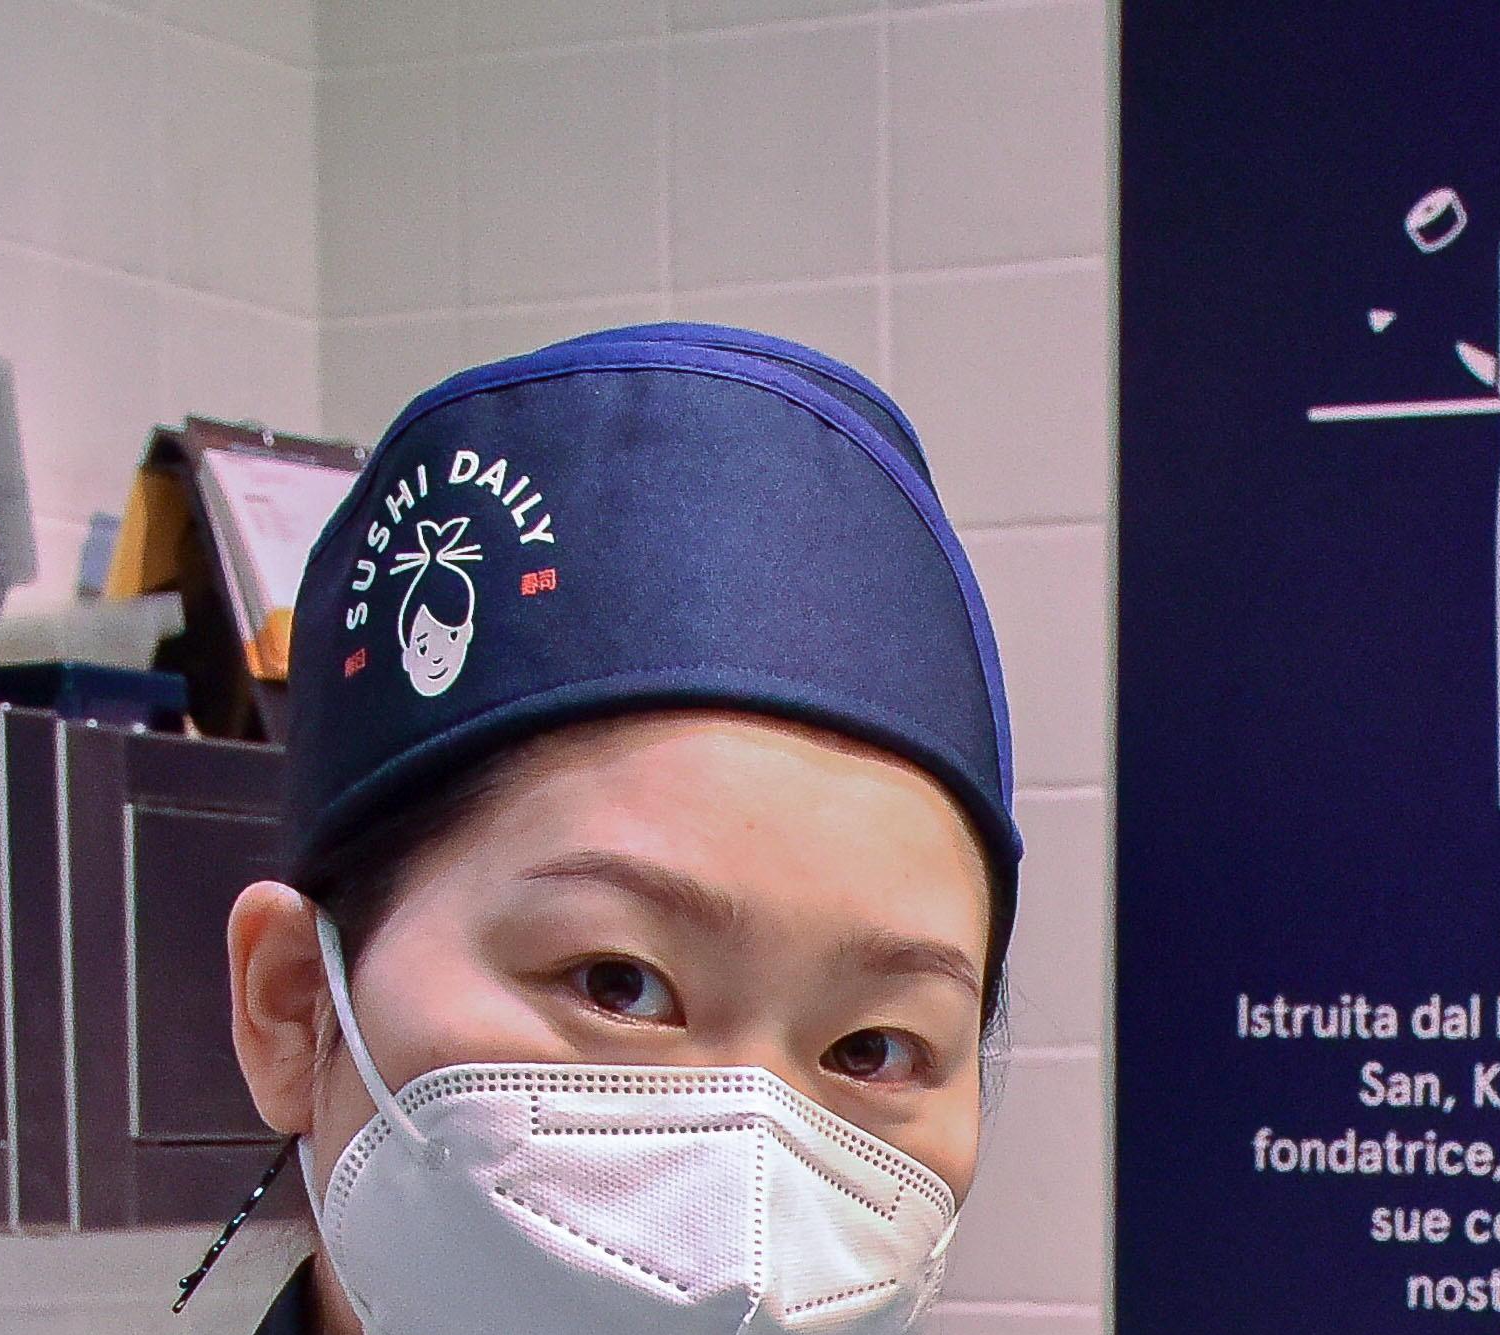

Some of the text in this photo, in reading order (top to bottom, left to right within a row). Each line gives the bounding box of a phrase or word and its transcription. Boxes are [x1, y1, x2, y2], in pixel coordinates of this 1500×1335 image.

[346, 449, 556, 631] SUSHI DAILY
[1238, 995, 1398, 1039] Istruita
[1411, 994, 1481, 1040] dal
[1359, 1061, 1455, 1112] San,
[1370, 1207, 1452, 1244] sue
